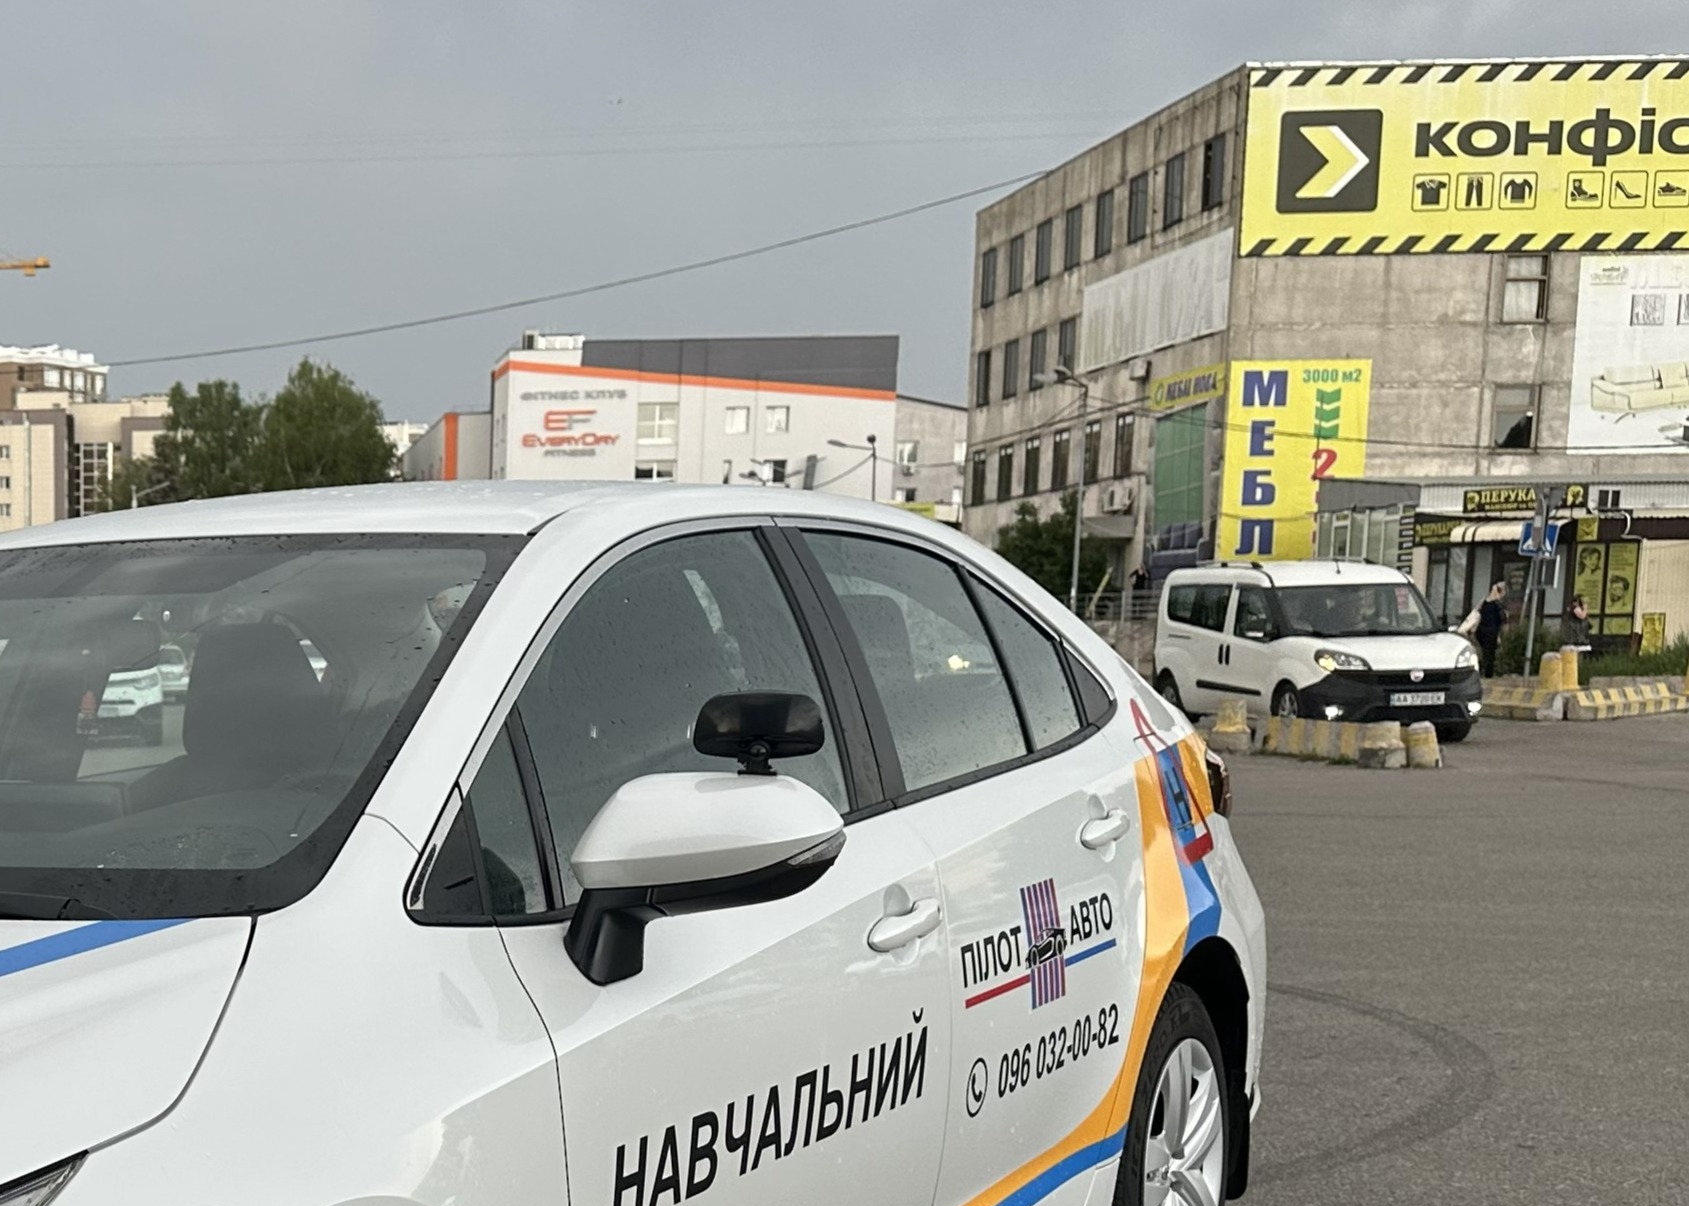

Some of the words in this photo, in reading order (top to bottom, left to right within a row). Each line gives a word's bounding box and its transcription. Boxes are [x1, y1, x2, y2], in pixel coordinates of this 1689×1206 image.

[1302, 369, 1339, 383] 3000
[520, 390, 579, 401] ФІТНЕС
[584, 390, 627, 400] КЛУБ
[543, 449, 596, 457] FITNESS
[1480, 488, 1537, 504] ПЕРУКА
[961, 925, 1022, 988] ПІЛОТ
[1070, 892, 1113, 946] АВТО
[998, 1043, 1031, 1098] 096
[1036, 1003, 1119, 1079] 032-00-82
